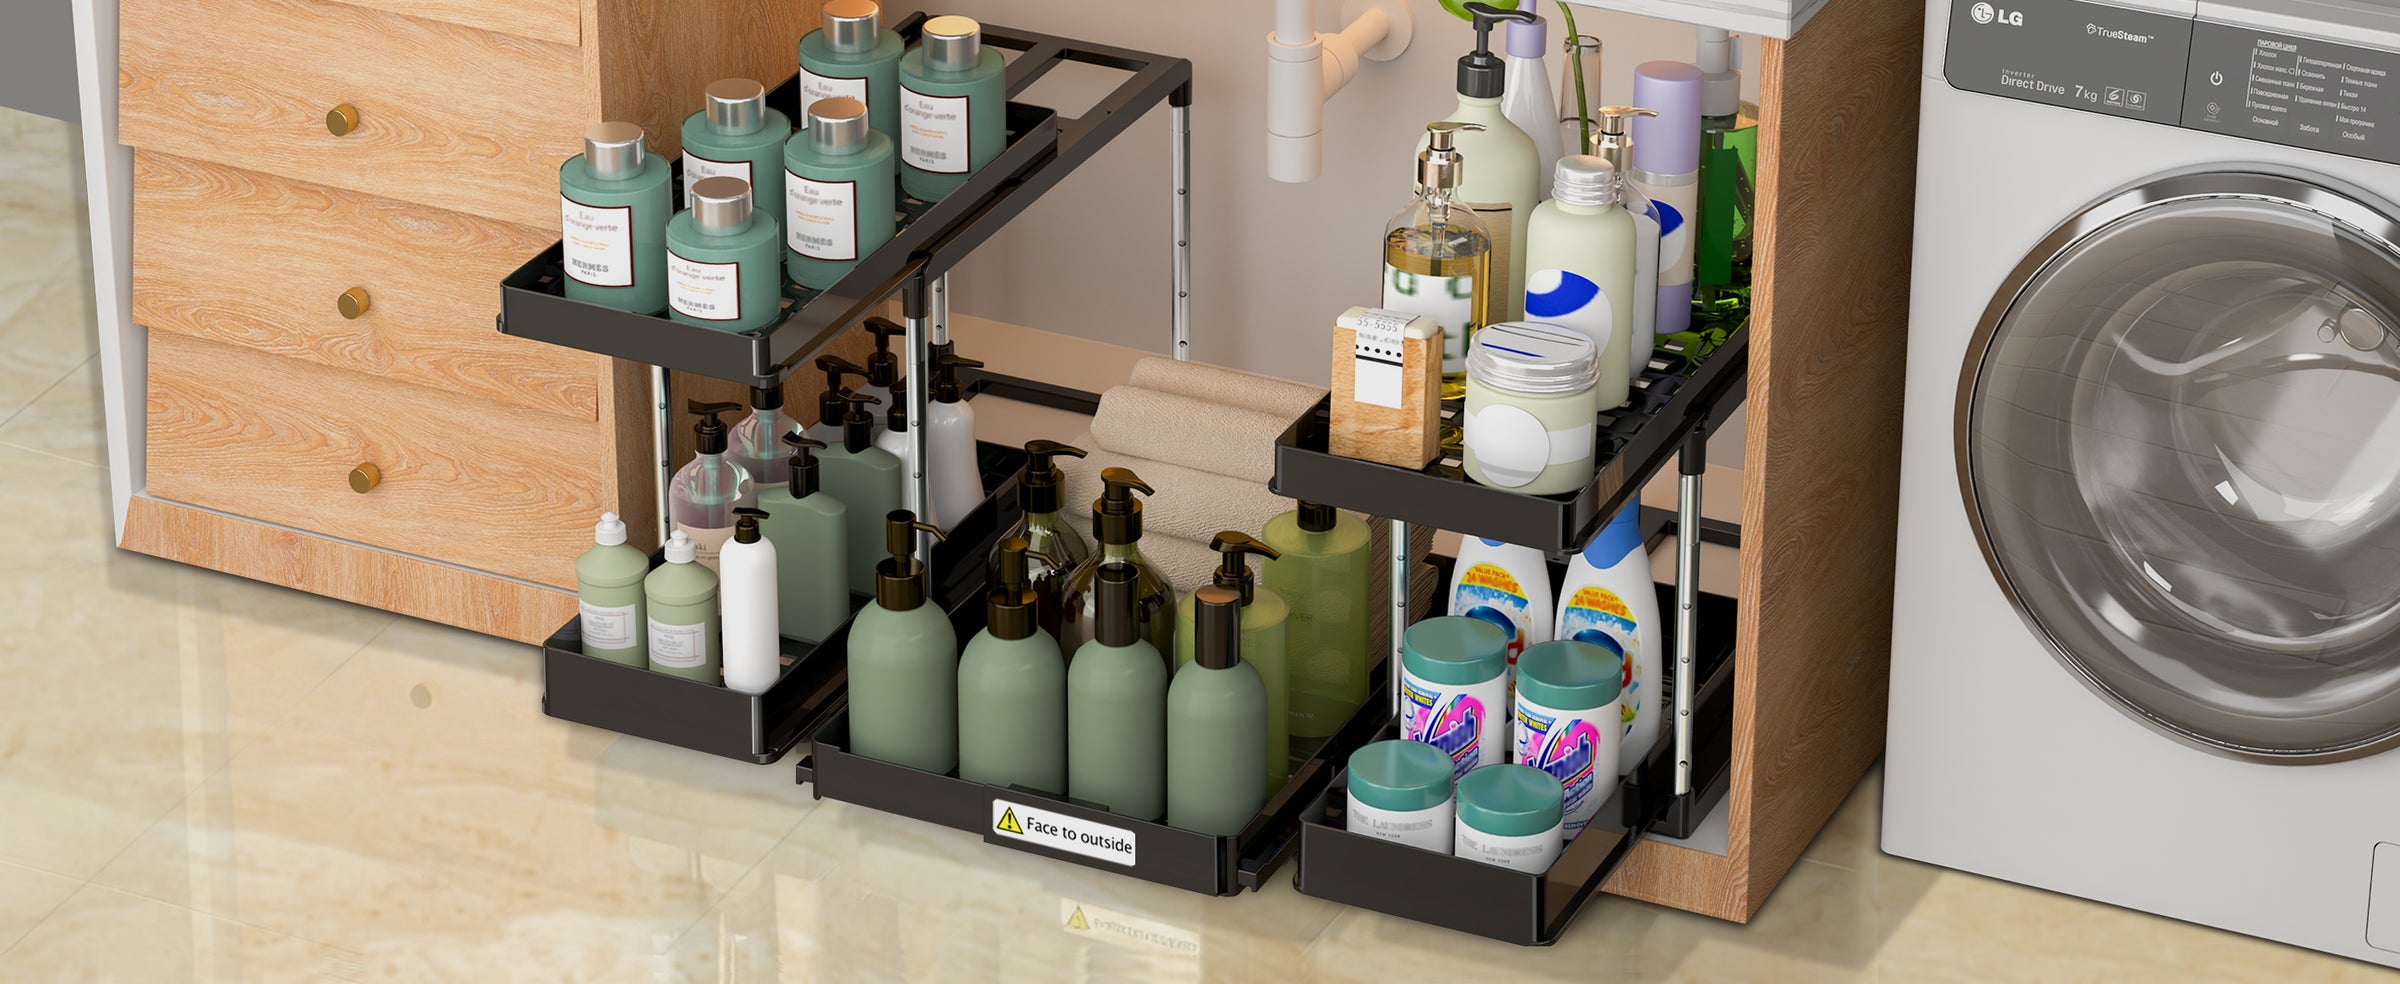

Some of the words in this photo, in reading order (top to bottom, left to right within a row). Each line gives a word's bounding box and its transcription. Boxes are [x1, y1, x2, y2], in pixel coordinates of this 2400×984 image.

[1998, 9, 2023, 26] LG
[2002, 68, 2035, 79] Inverter
[2001, 75, 2034, 90] Direct
[2036, 81, 2065, 95] Drive
[1027, 816, 1058, 836] Face
[1062, 827, 1077, 841] to
[1081, 833, 1133, 854] outside
